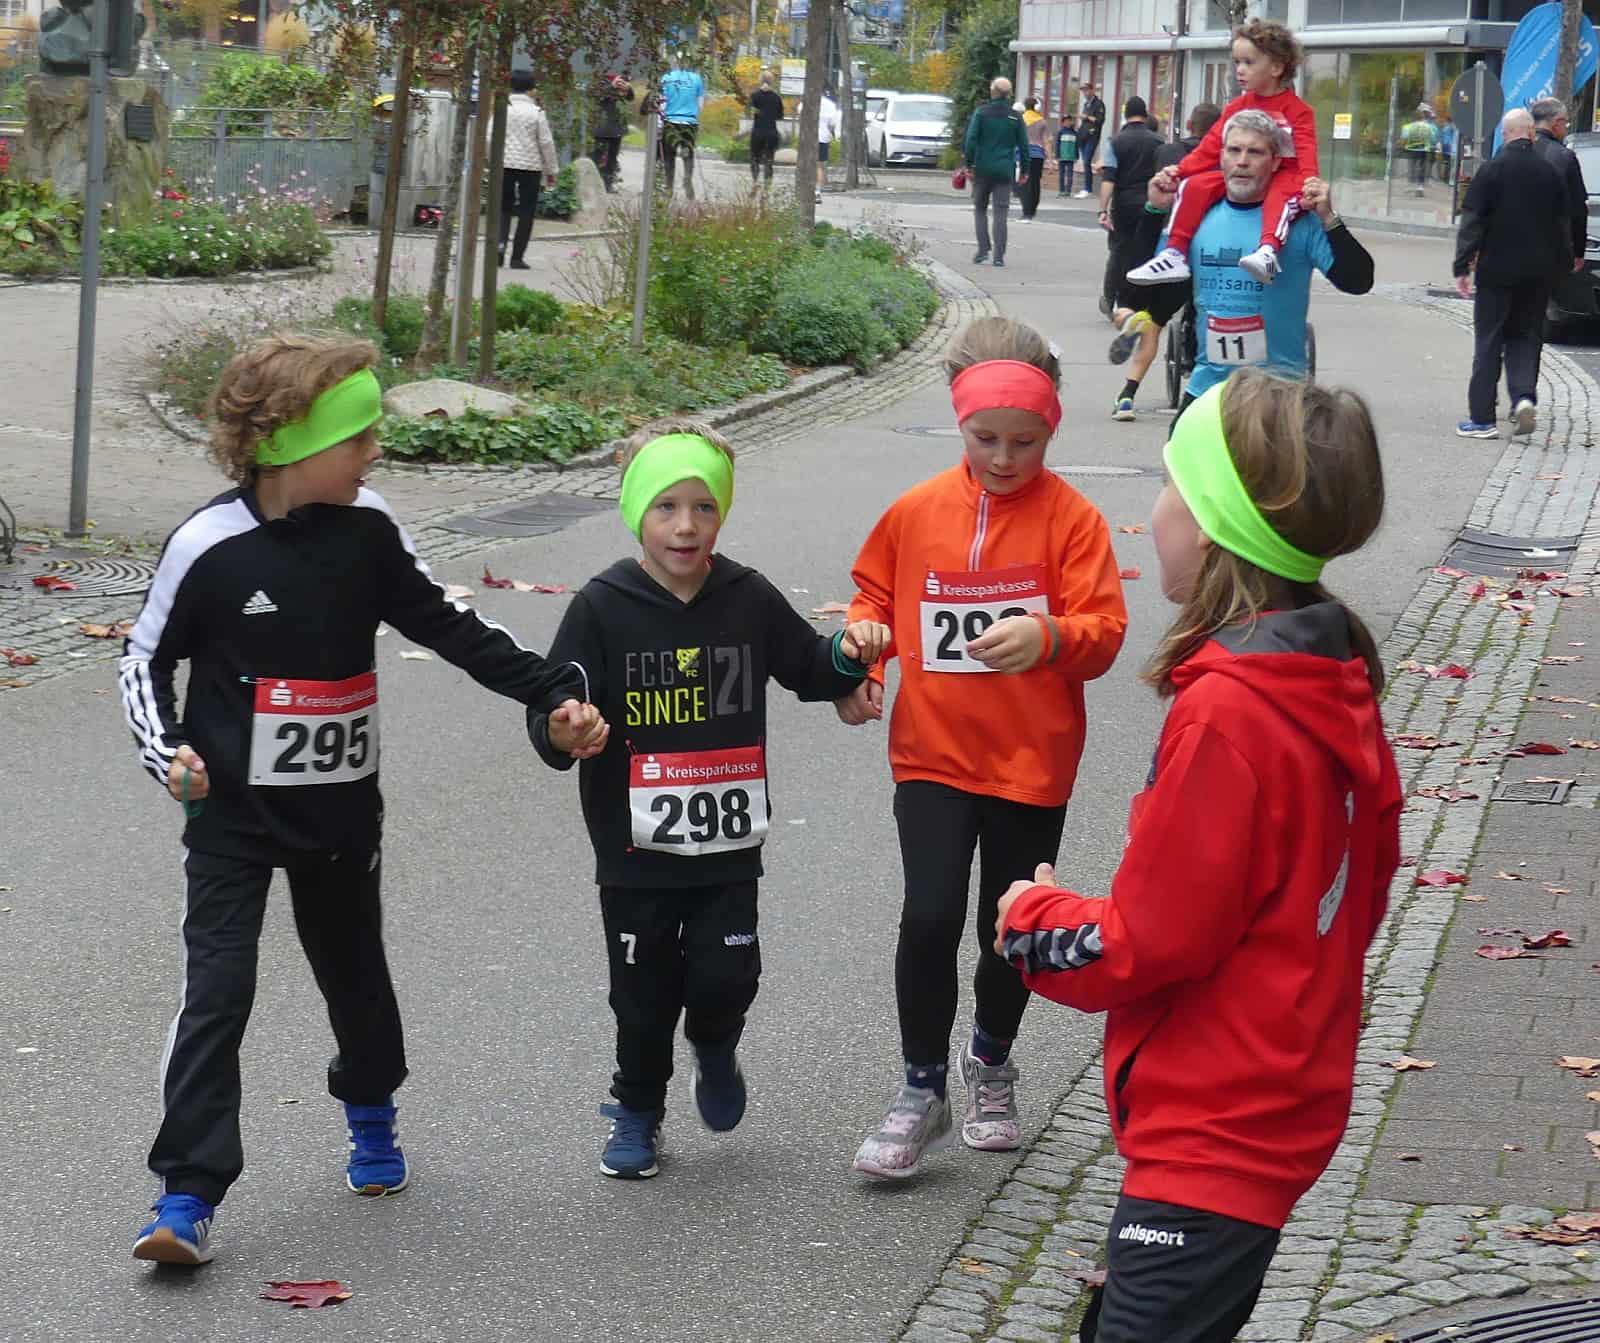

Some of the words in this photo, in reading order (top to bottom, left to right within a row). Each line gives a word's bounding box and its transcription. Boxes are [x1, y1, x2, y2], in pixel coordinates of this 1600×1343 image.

[1216, 335, 1245, 360] 11
[943, 579, 1037, 598] Kreissparkasse
[934, 606, 1028, 660] 29
[625, 651, 674, 687] FCG
[626, 686, 706, 726] SINCE
[272, 714, 369, 774] 295
[666, 761, 758, 779] Kreissparkasse
[650, 788, 752, 844] 298
[620, 932, 637, 965] 7
[1118, 1223, 1185, 1247] uhlsport
